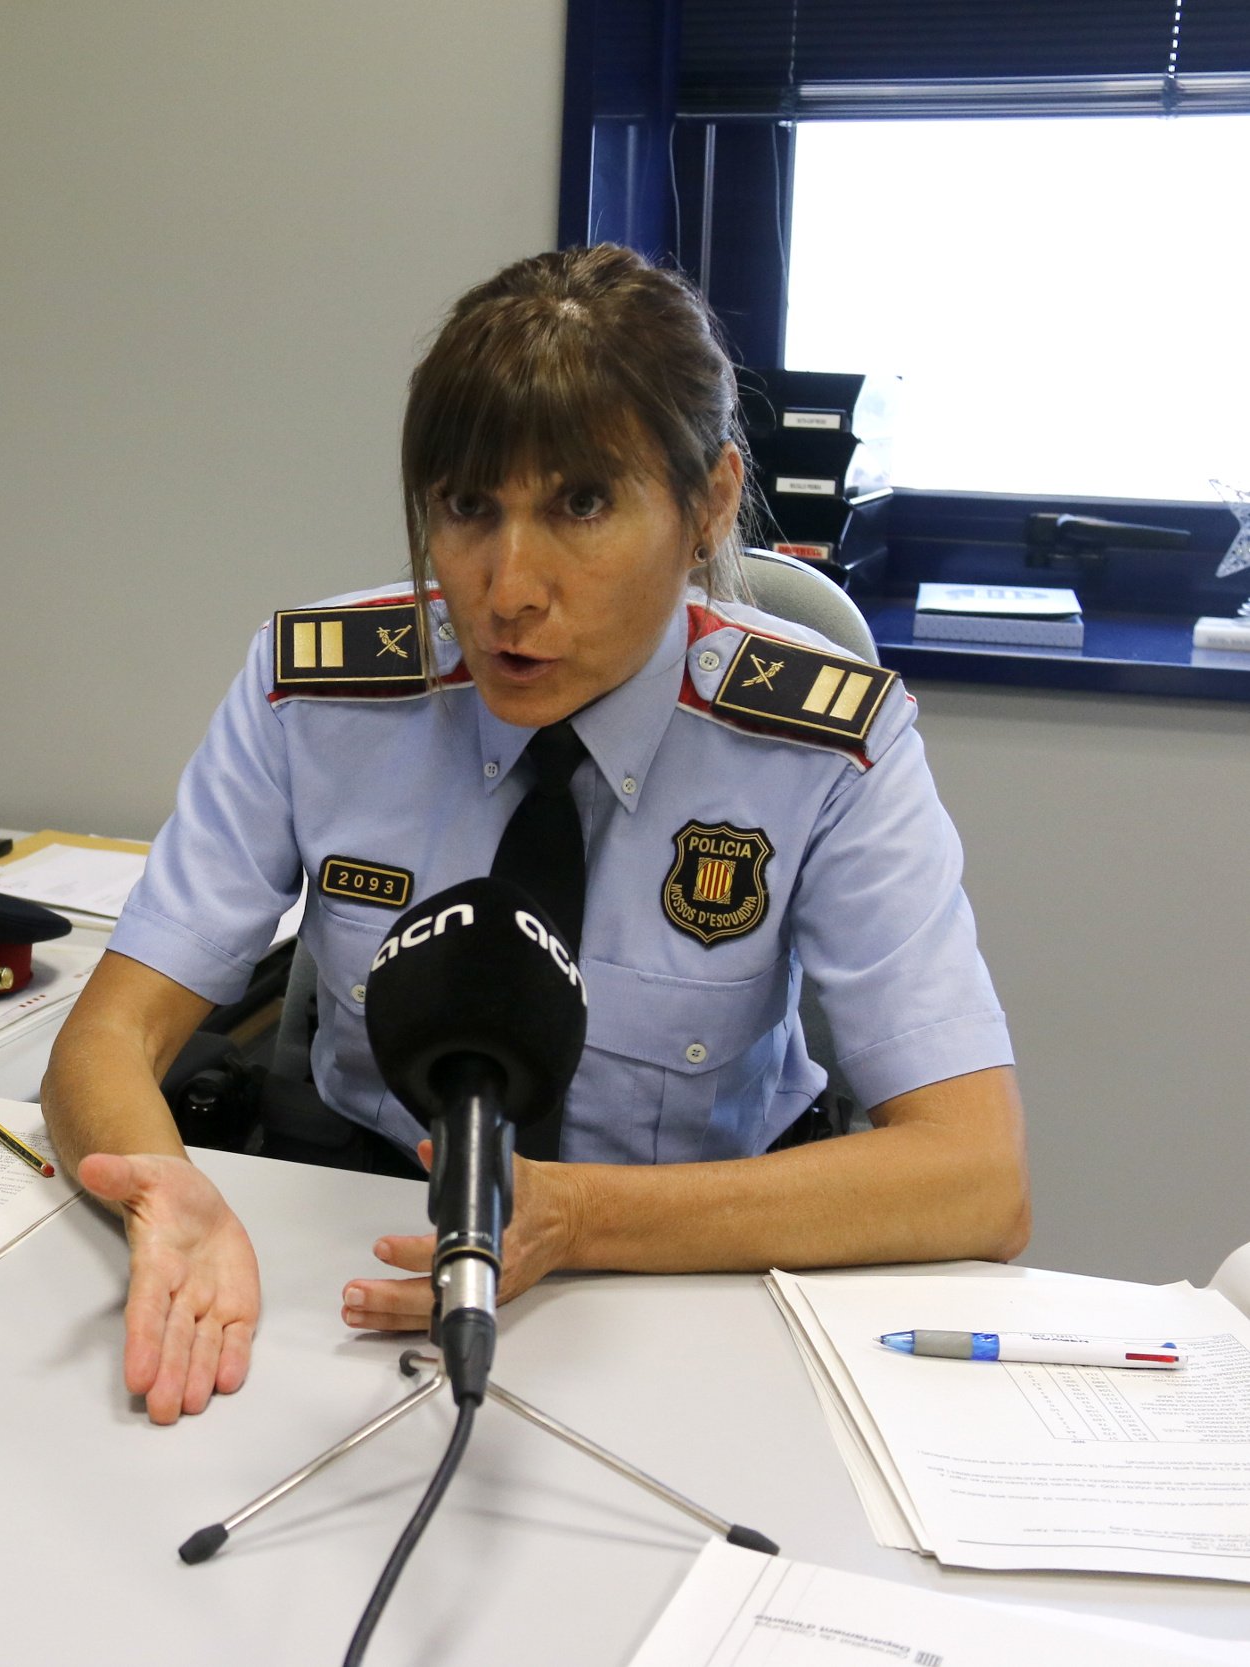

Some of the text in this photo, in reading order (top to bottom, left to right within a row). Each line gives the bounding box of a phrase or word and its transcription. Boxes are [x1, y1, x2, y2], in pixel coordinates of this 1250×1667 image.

[689, 836, 751, 858] POLICIA
[338, 871, 394, 894] 2093
[670, 883, 758, 927] MOSSOS D'ESQUADRA
[371, 904, 474, 972] acn
